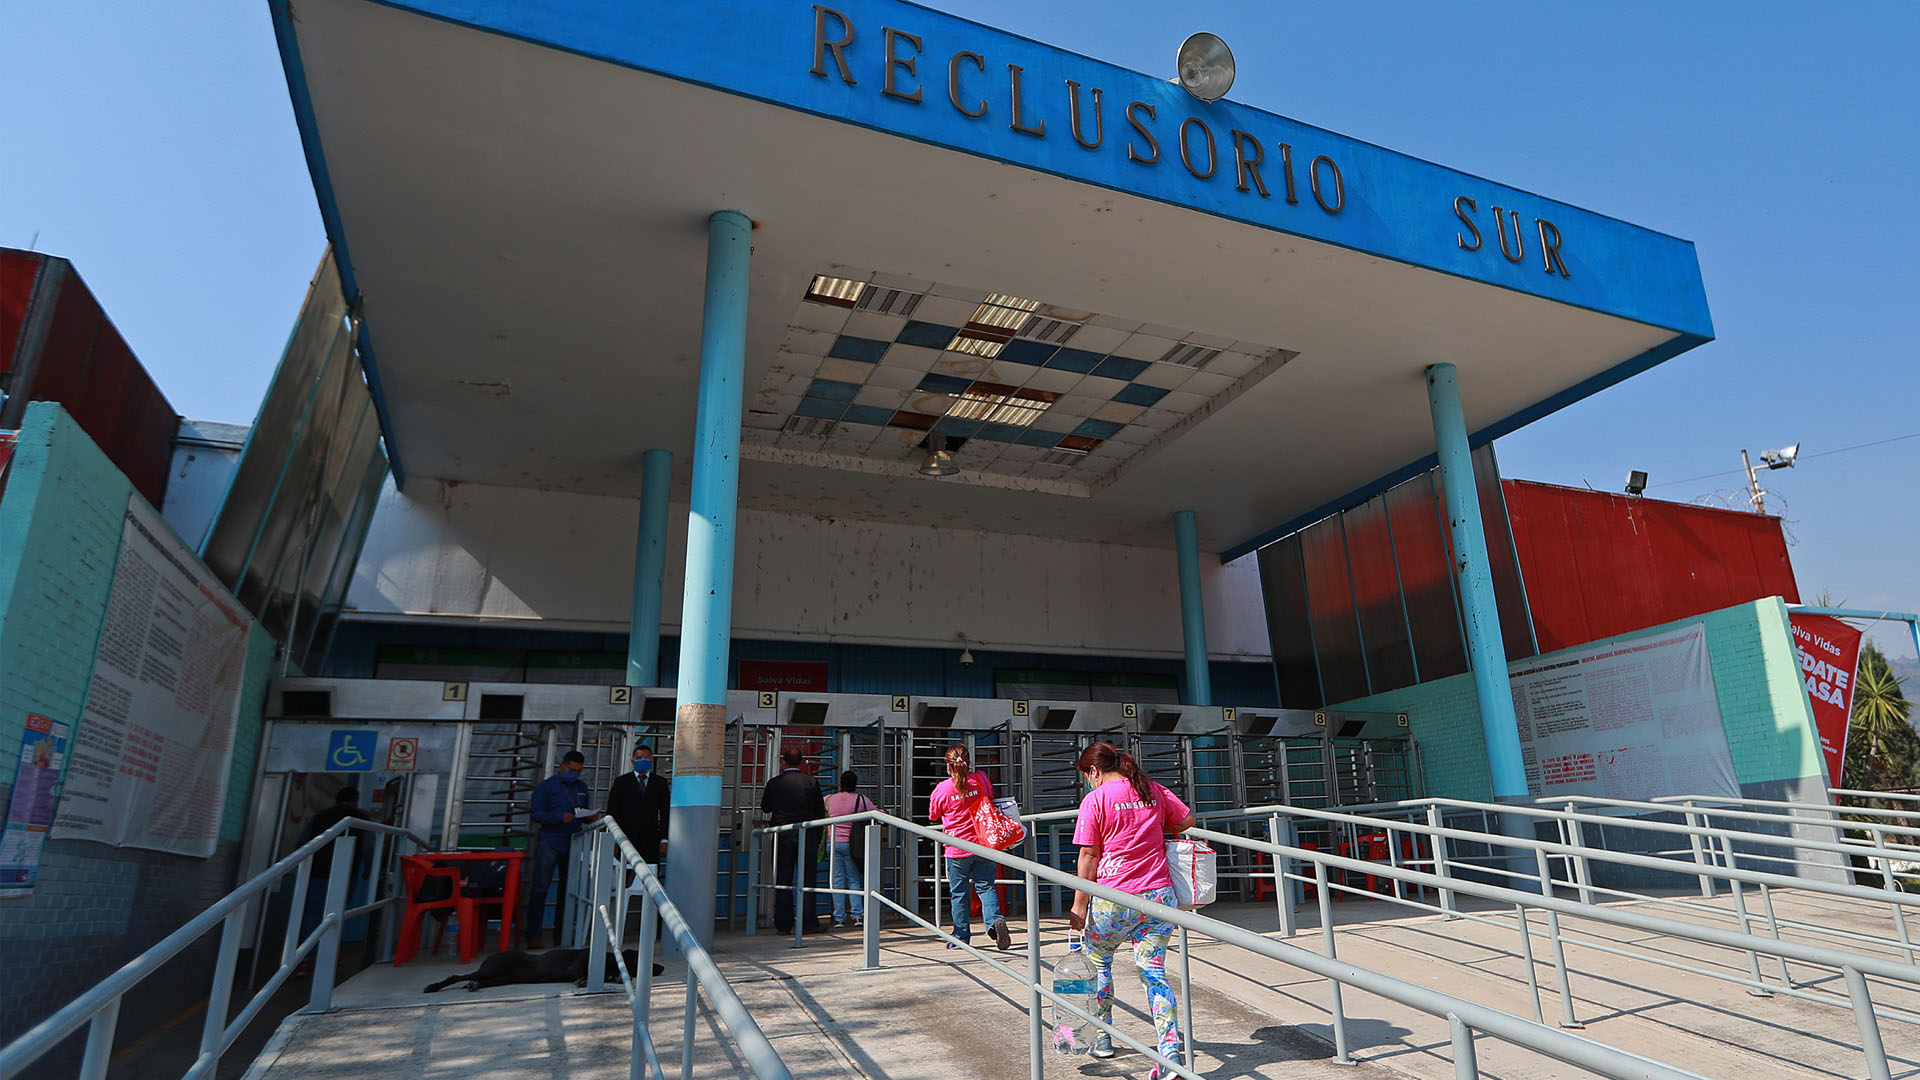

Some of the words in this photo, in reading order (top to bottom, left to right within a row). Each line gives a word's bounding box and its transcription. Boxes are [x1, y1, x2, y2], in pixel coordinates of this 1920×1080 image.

[809, 4, 1346, 213] RECLUSORIO
[1454, 196, 1571, 277] SUR
[1791, 624, 1811, 642] alva
[1814, 633, 1841, 657] Vidas
[1796, 645, 1850, 690] ÉDATE
[758, 676, 783, 685] Salva
[786, 676, 812, 686] Vidas
[449, 684, 459, 699] 1
[614, 688, 627, 702] 2
[1803, 673, 1846, 710] ASA
[762, 693, 774, 706] 3
[895, 697, 906, 710] 4
[1016, 701, 1026, 714] 5
[1125, 704, 1134, 716] 6
[1225, 709, 1233, 720] 7
[1316, 713, 1324, 724] 8
[1399, 714, 1407, 726] 9
[1114, 800, 1157, 811] SAMSUG
